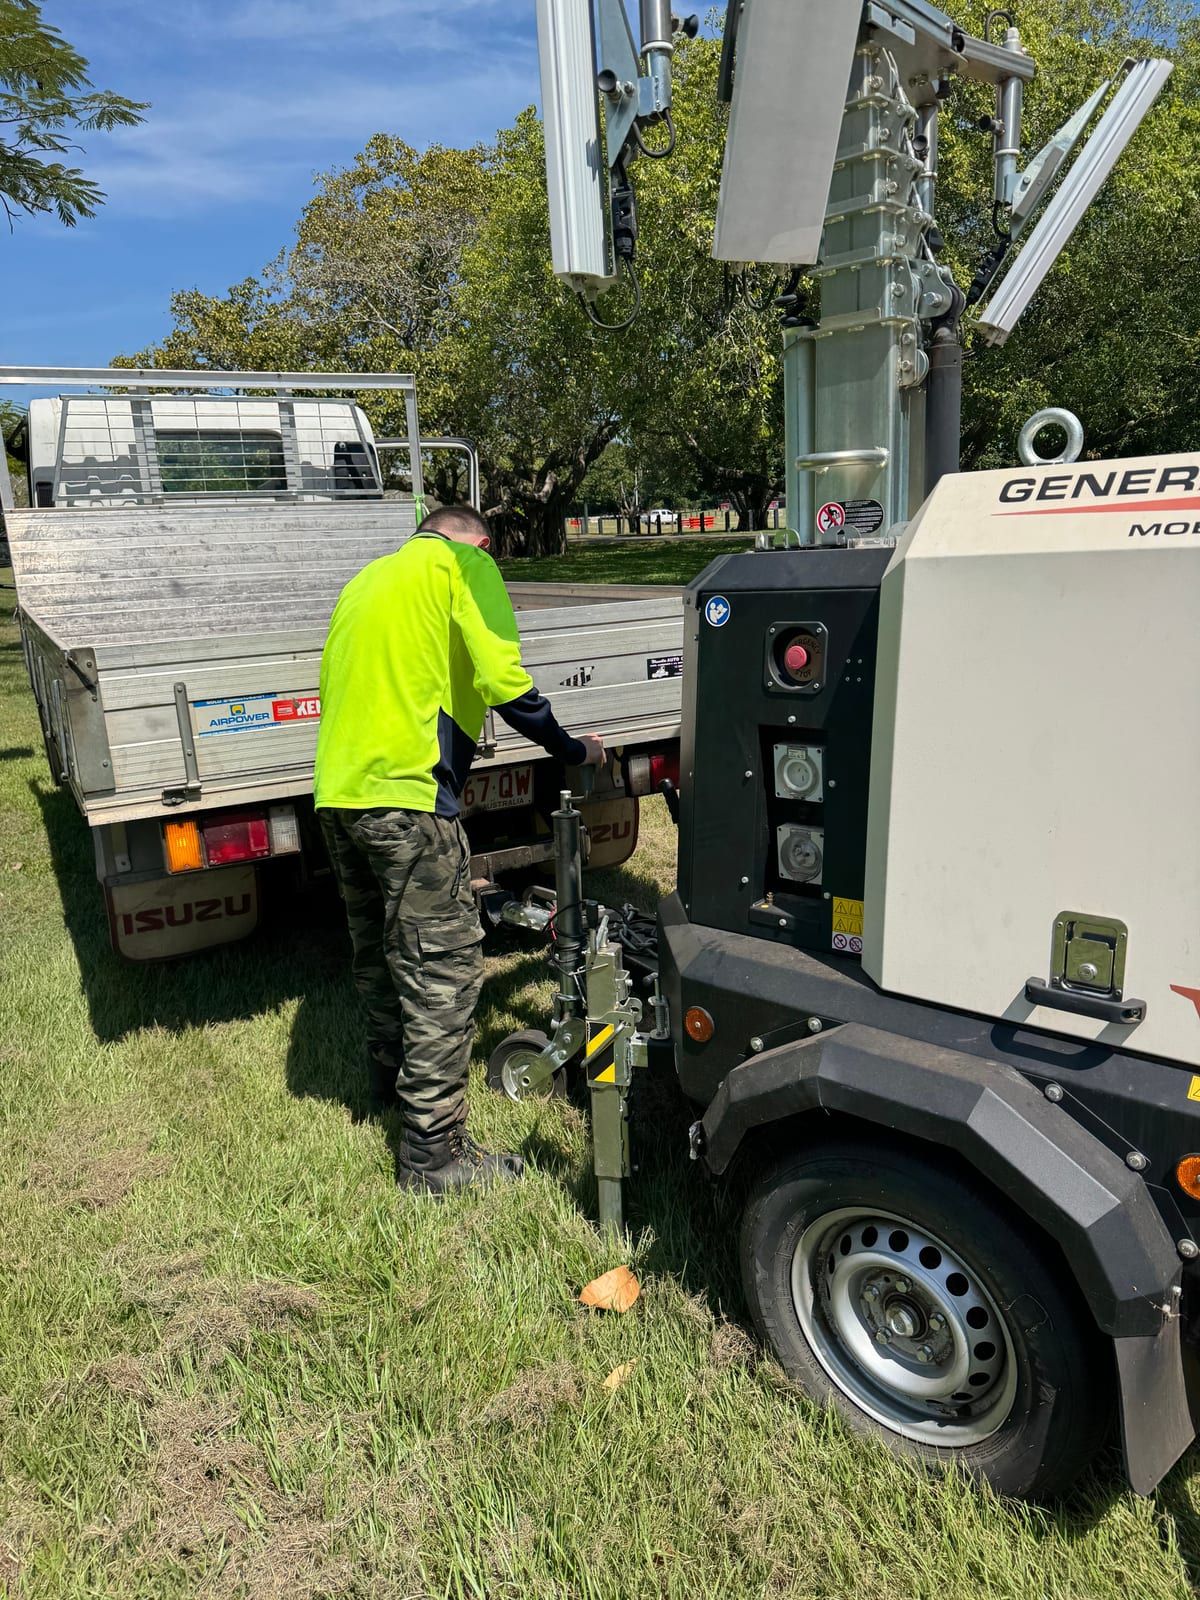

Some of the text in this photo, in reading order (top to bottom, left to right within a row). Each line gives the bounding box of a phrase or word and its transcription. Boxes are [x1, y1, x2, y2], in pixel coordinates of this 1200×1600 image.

[999, 466, 1200, 503] GENER
[209, 713, 270, 727] AIRPOWER
[590, 821, 631, 843] ZU
[122, 894, 251, 936] ISUZU
